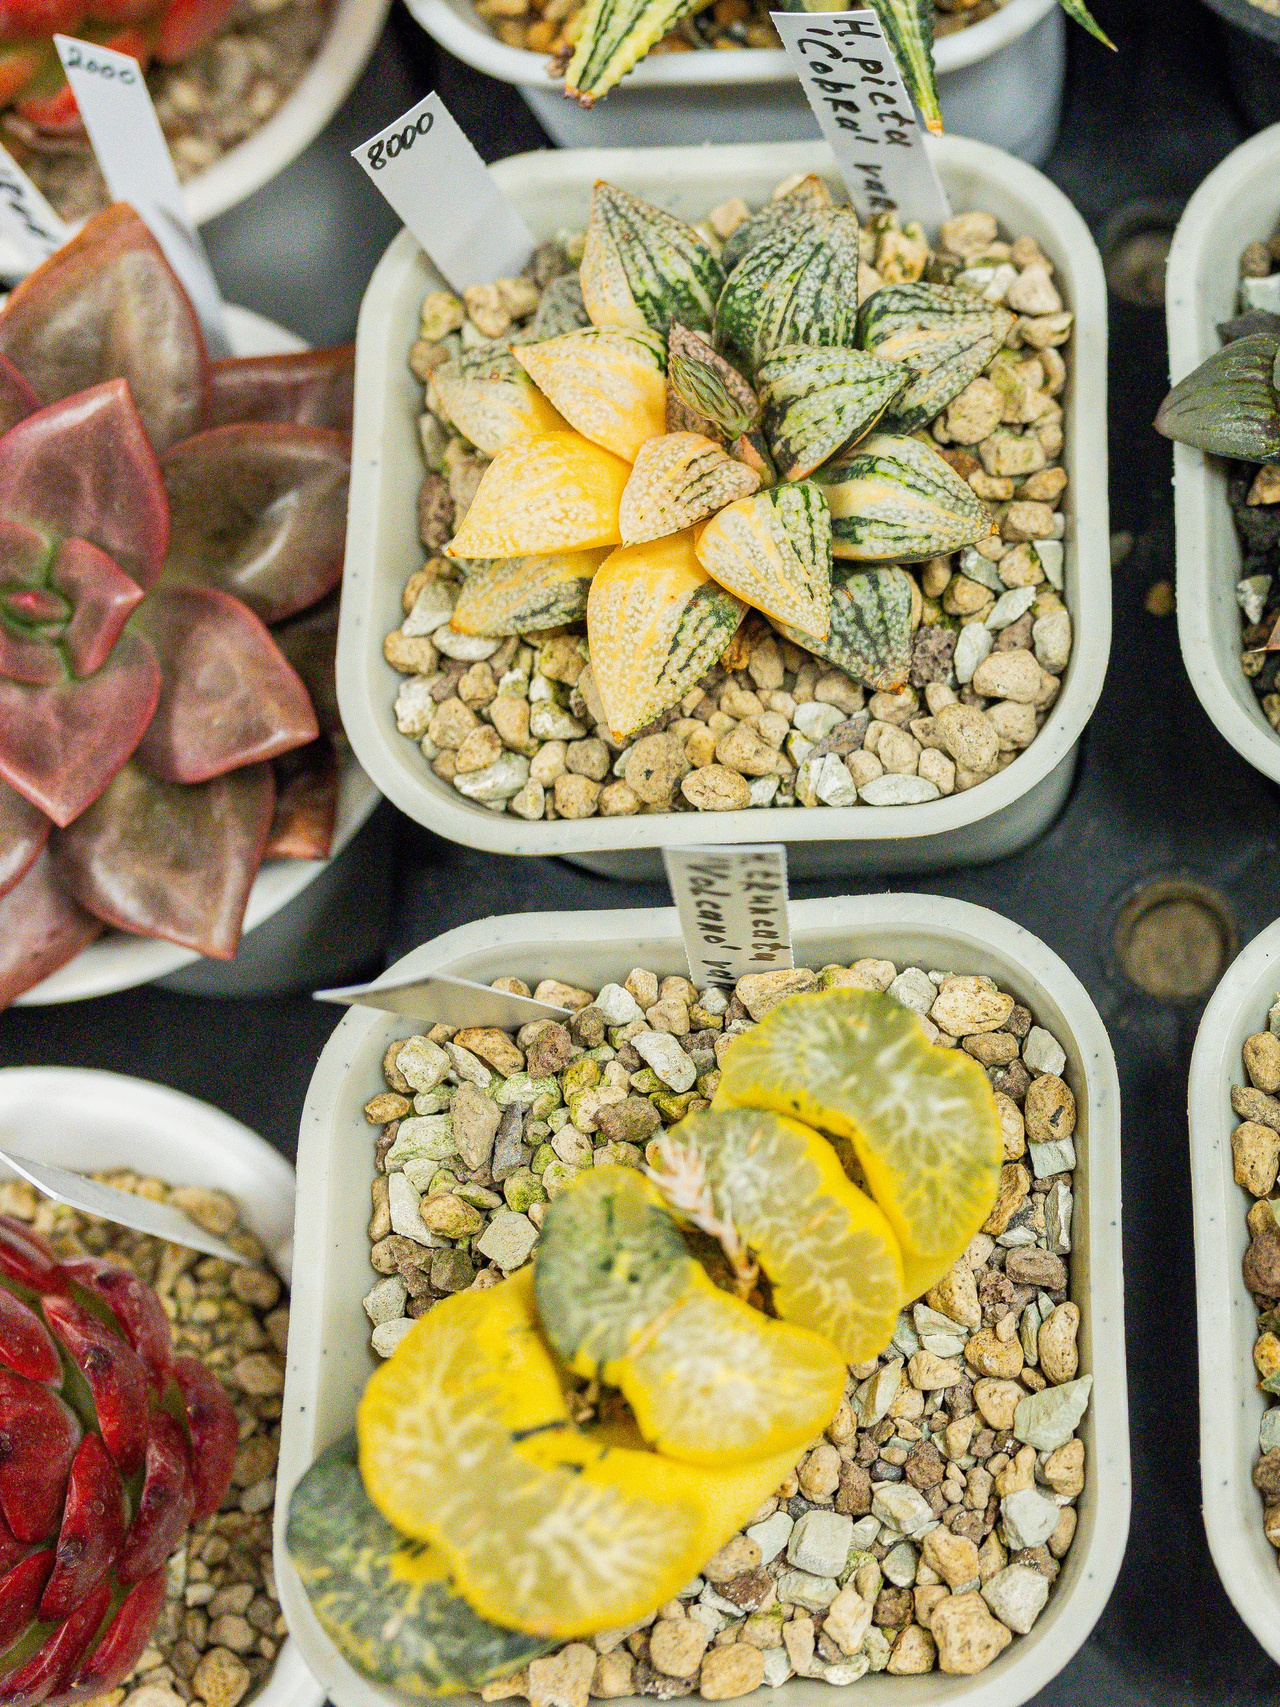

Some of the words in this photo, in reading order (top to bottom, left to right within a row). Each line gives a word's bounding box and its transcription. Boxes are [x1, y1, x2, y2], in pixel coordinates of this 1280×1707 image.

[833, 19, 881, 46] H.
[67, 46, 136, 85] 2000
[842, 56, 916, 148] picta
[367, 112, 434, 170] 8000
